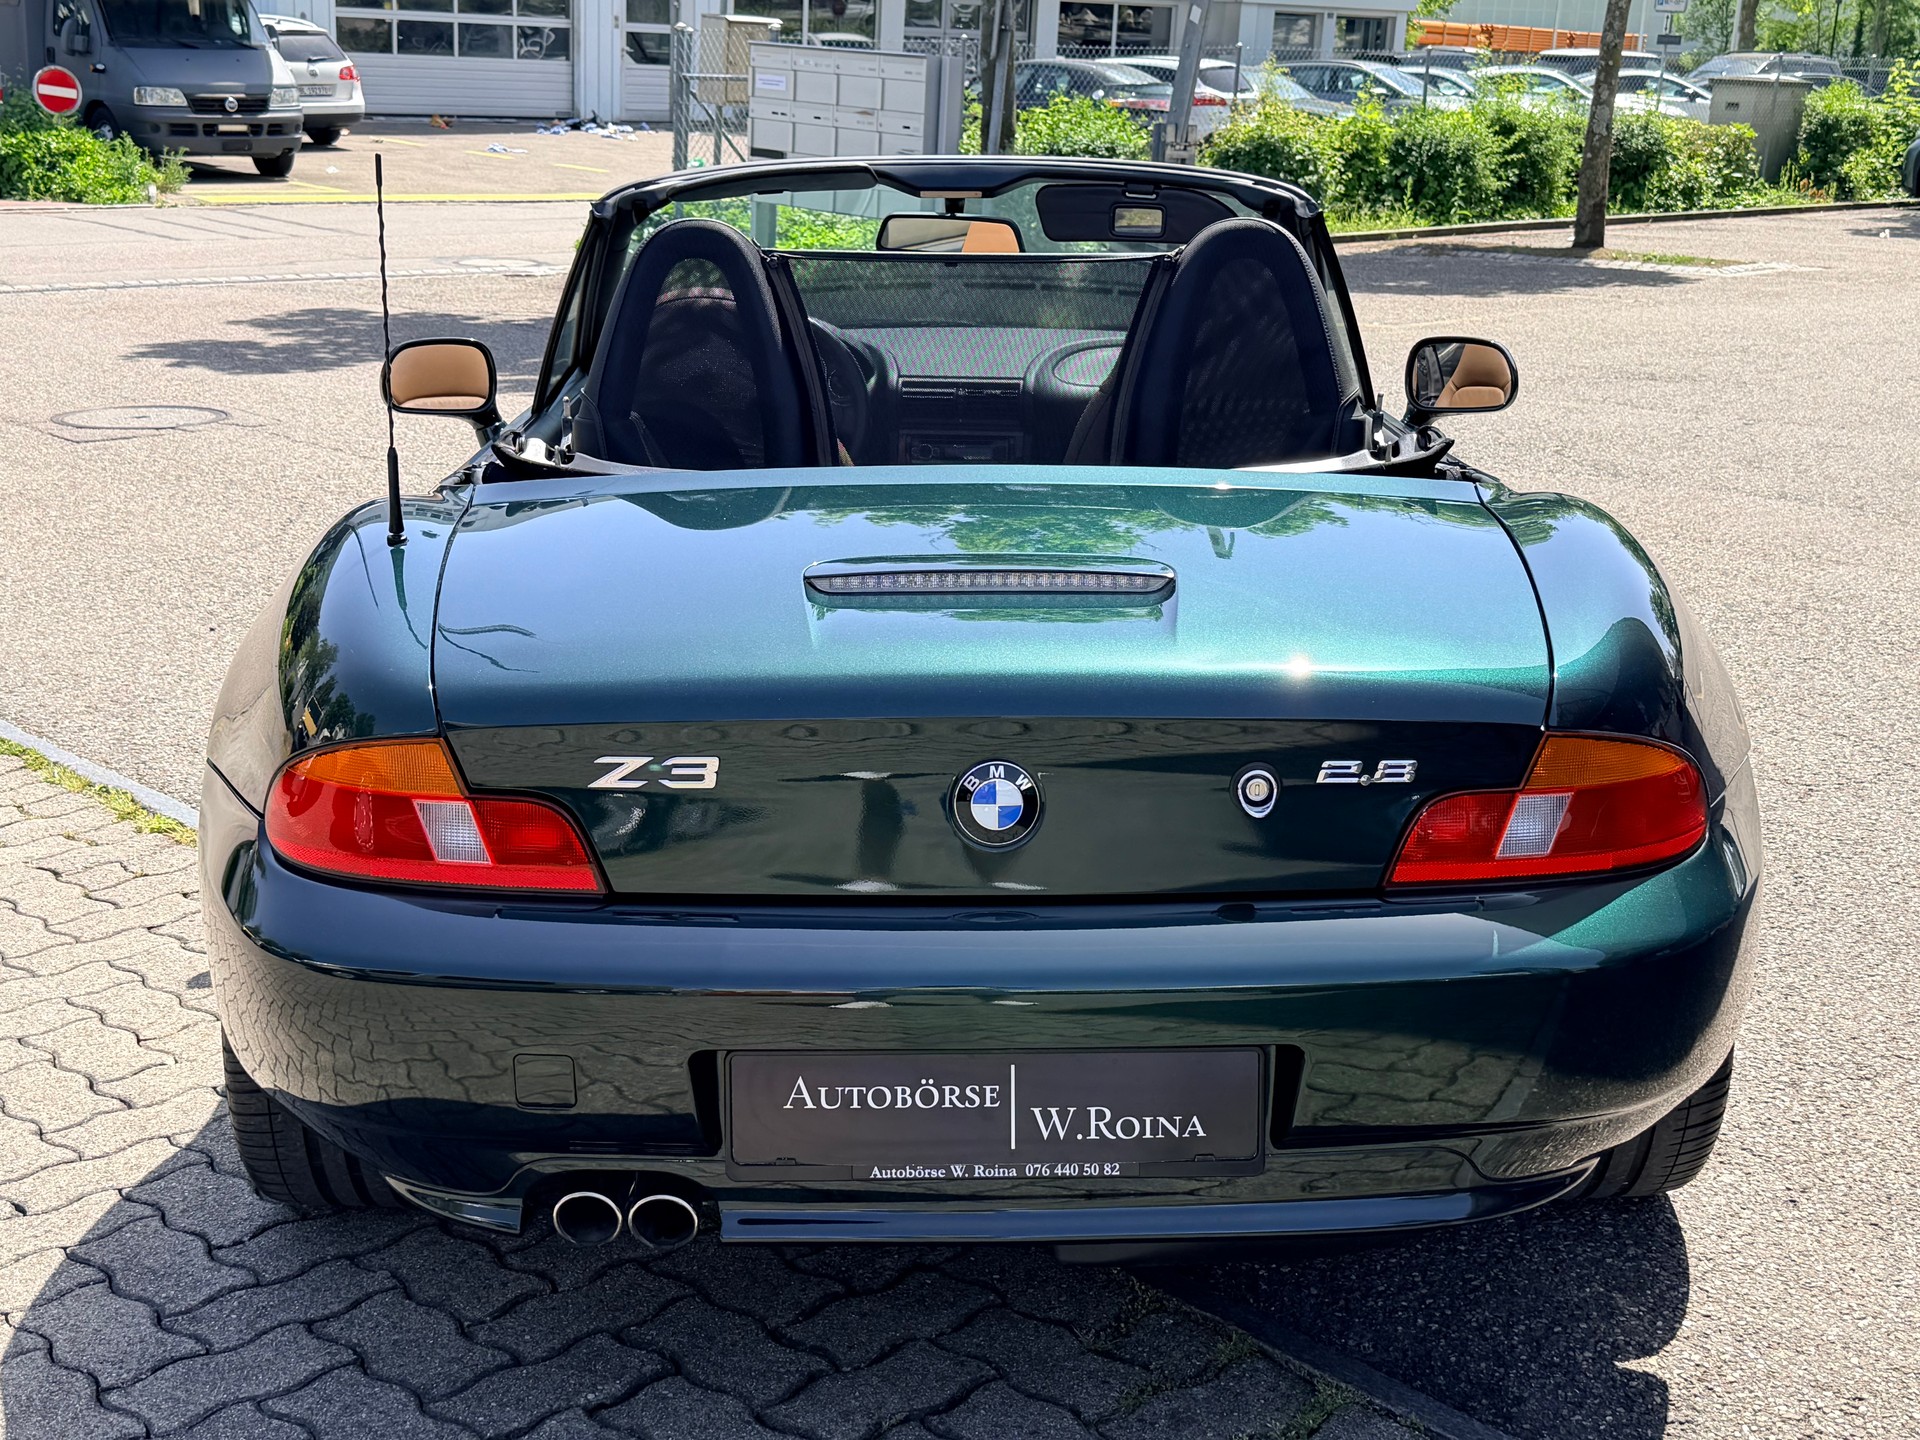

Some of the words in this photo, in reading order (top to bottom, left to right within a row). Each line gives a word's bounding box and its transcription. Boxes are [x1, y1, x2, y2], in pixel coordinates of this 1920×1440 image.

[587, 756, 720, 789] Z3
[963, 765, 1032, 792] BMW
[1316, 760, 1418, 787] 2.8
[783, 1076, 1000, 1109] AUTOBÖRSE
[869, 1165, 946, 1179] Autobörse
[950, 1165, 969, 1178] W.
[973, 1164, 1017, 1177] Roina
[1025, 1164, 1050, 1177] 076
[1053, 1163, 1079, 1176] 440
[1083, 1163, 1099, 1176] 50
[1103, 1162, 1120, 1175] 82
